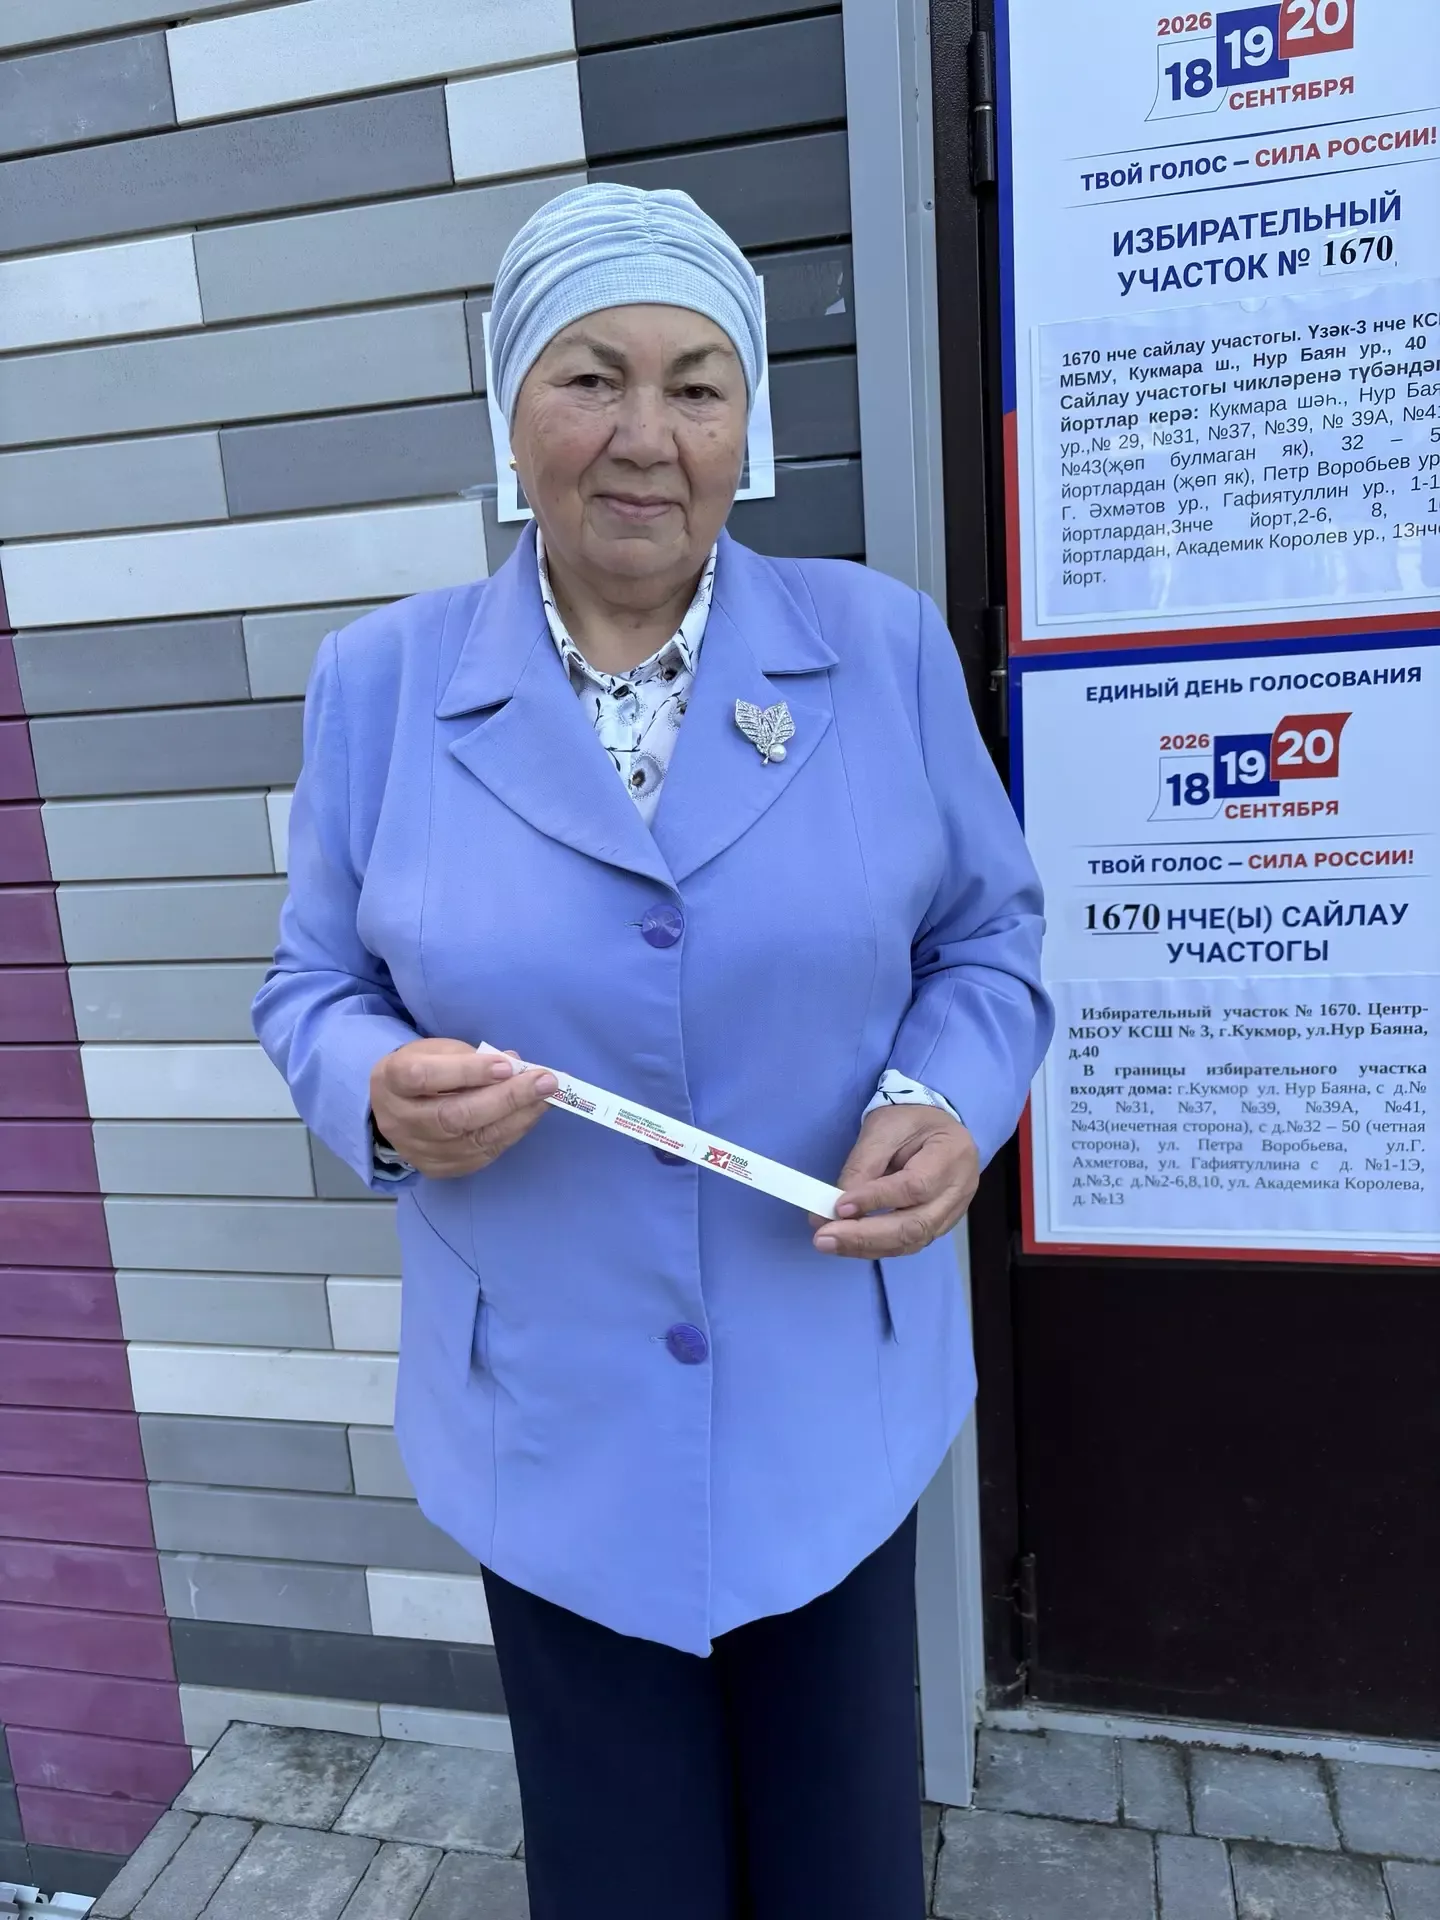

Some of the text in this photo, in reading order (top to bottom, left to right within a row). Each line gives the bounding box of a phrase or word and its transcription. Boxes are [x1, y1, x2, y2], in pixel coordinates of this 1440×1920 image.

[1158, 12, 1212, 36] 2026
[1165, 0, 1348, 101] 18 19 20
[1229, 76, 1354, 111] СЕНТЯБРЯ
[1080, 162, 1143, 191] ТВОЙ
[1150, 155, 1227, 182] ГОЛОС
[1256, 143, 1321, 167] СИЛА
[1328, 126, 1437, 158] РОССИИ!
[1114, 189, 1401, 257] ИЗБИРАТЕЛЬНЫЙ
[1118, 235, 1393, 297] УЧАСТОК № 1670
[1062, 312, 1440, 367] 1670 нче сайлау участогы. Үзәк-3 нче КС
[1060, 336, 1427, 389] МБМУ, Кукмара ш., Нур Баян ур., 40
[1060, 391, 1130, 410] Сайлау
[1136, 382, 1226, 407] участогы
[1234, 369, 1342, 392] чикләренә
[1061, 414, 1139, 435] йортлар
[1149, 408, 1198, 429] керә:
[1210, 399, 1288, 421] Кукмара
[1360, 386, 1396, 406] Нур
[1323, 414, 1344, 430] №
[1170, 448, 1256, 471] булмаган
[1282, 439, 1313, 460] як),
[1342, 432, 1364, 451] 32
[1062, 479, 1165, 501] йортлардан
[1224, 468, 1255, 488] як),
[1264, 464, 1309, 483] Петр
[1318, 456, 1410, 479] Воробьев
[1062, 506, 1076, 521] Г.
[1090, 502, 1166, 519] Әхмәтов
[1178, 498, 1209, 516] ур.,
[1224, 485, 1348, 509] Гафиятуллин
[1362, 482, 1395, 500] ур.,
[1372, 502, 1387, 519] 8,
[1428, 498, 1440, 513] 1
[1063, 522, 1440, 566] йортлардан, Академик Королев ур., 13нч
[1063, 570, 1106, 588] йорт.
[1086, 666, 1422, 704] ЕДИНЫЙ ДЕНЬ ГОЛОСОВАНИЯ
[1160, 734, 1210, 751] 2026
[1166, 729, 1333, 807] 18 19 20
[1225, 800, 1339, 819] СЕНТЯБРЯ
[1088, 855, 1145, 875] ТВОЙ
[1152, 856, 1223, 873] ГОЛОС
[1248, 854, 1308, 870] СИЛА
[1314, 850, 1413, 868] РОССИИ!
[1084, 900, 1409, 935] 1670 НЧЕ(Ы) САЙЛАУ
[1166, 940, 1328, 964] УЧАСТОГЫ
[731, 1155, 748, 1167] 2026
